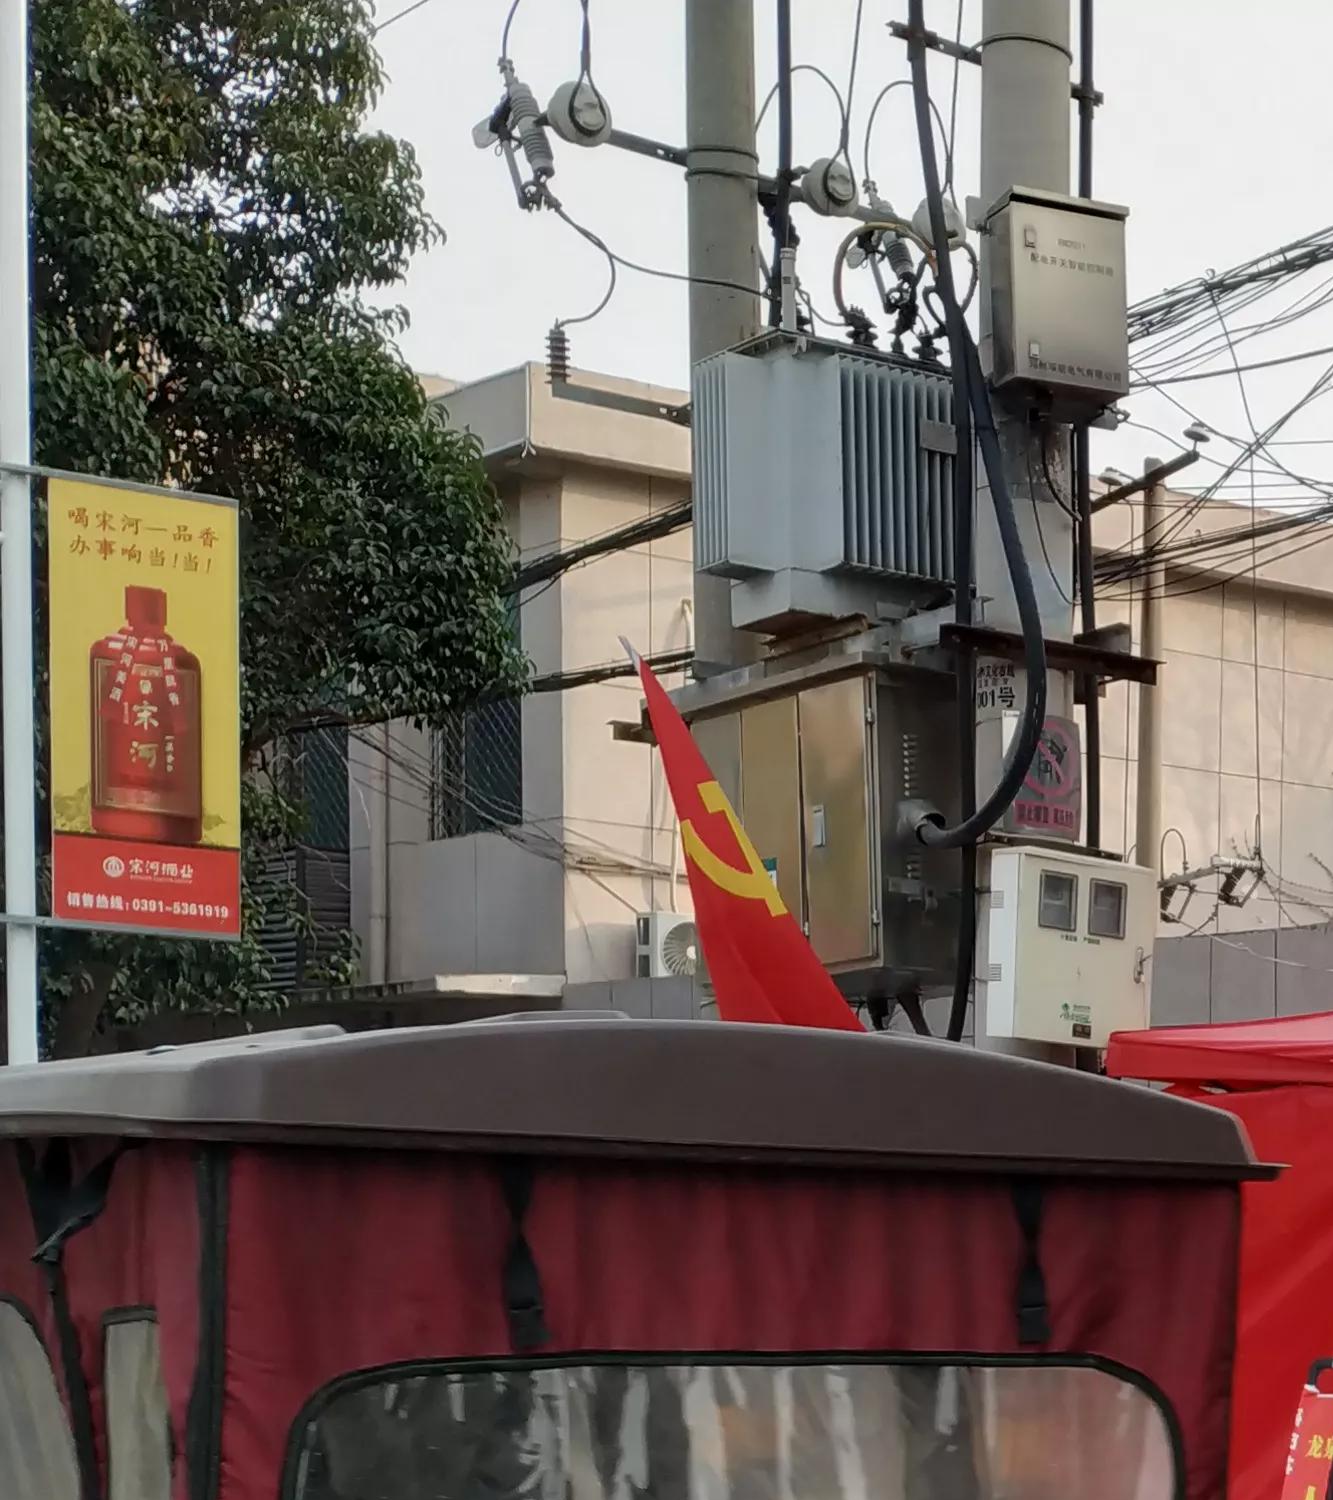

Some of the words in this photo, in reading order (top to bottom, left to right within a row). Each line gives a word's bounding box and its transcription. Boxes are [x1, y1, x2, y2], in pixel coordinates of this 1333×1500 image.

[68, 507, 219, 549] 喝宋河一品香
